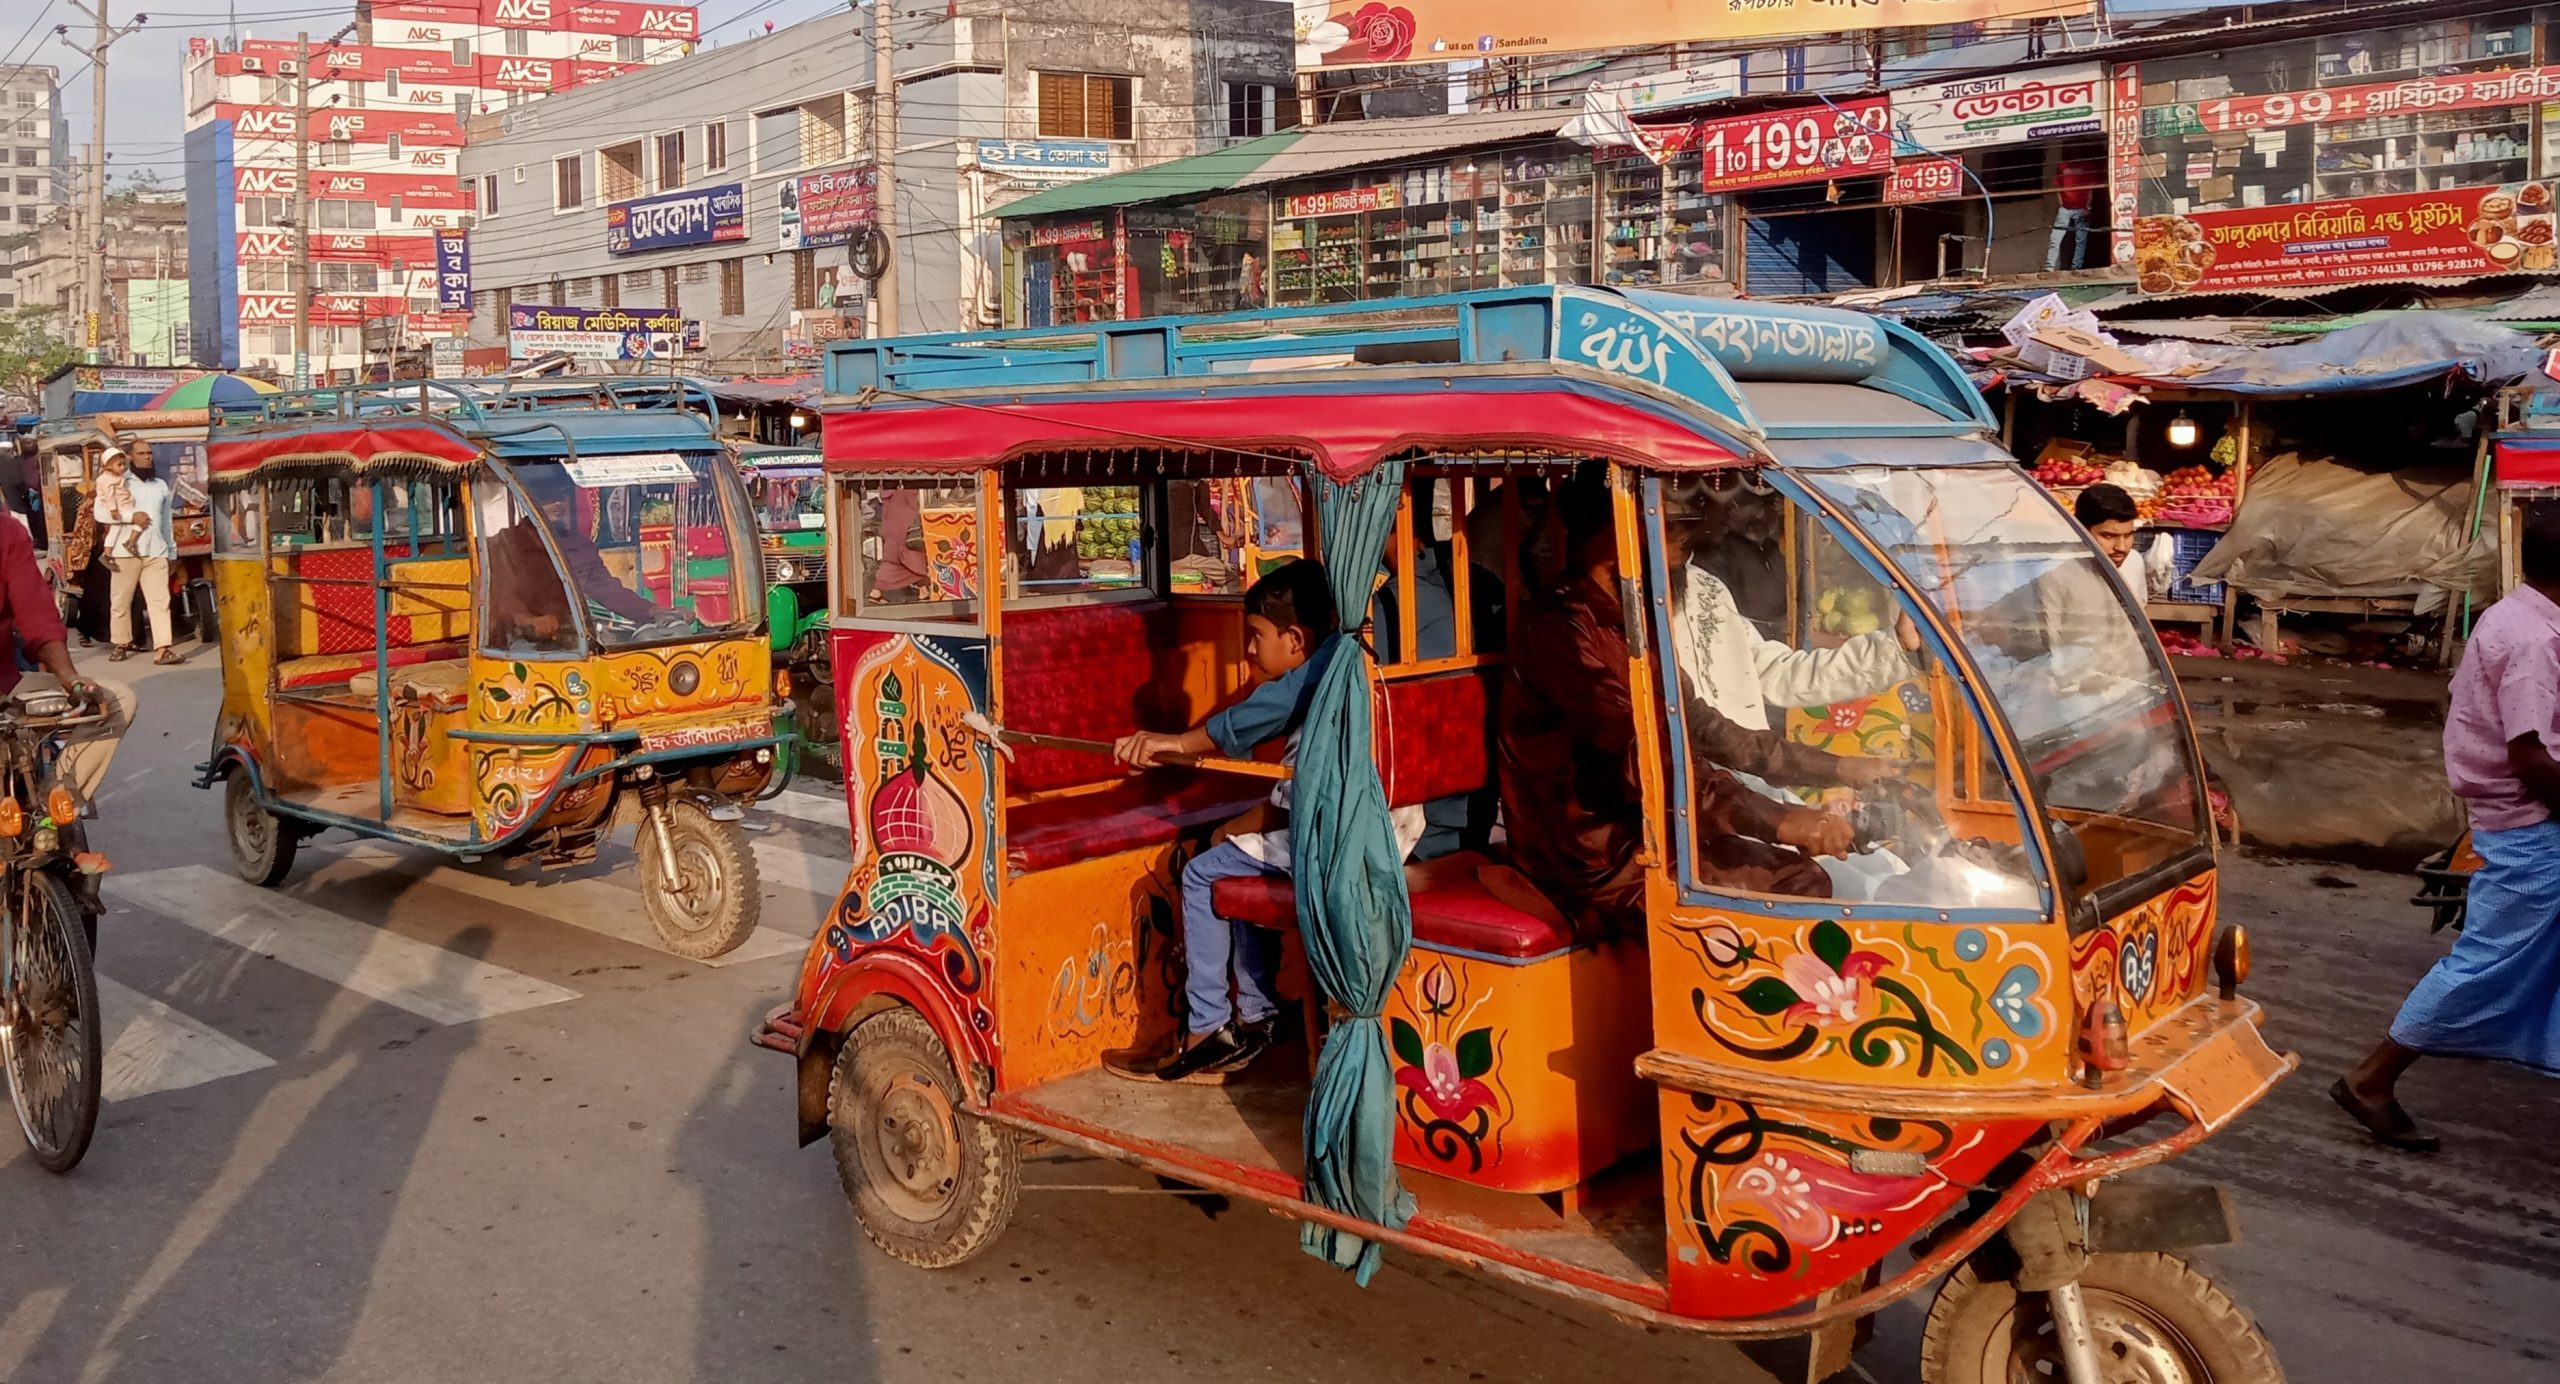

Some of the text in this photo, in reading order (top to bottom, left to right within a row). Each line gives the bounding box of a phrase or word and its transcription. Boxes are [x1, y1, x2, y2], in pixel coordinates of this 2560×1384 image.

[496, 0, 551, 20] AKS
[640, 10, 693, 32] AKS
[407, 27, 441, 41] AKS
[1496, 37, 1548, 49] /Sandalina
[580, 39, 612, 52] AKS
[326, 52, 362, 67] AKS
[497, 60, 552, 81] AKS
[1941, 77, 2007, 100] মাজেদা
[2119, 65, 2137, 97] 1
[409, 90, 443, 103] AKS
[1953, 81, 2096, 120] ডেন্টাল
[2118, 98, 2138, 112] to
[2206, 102, 2233, 130] 1
[2234, 111, 2259, 127] to
[2263, 91, 2331, 126] 99
[236, 110, 297, 133] AKS
[329, 115, 365, 131] AKS
[2116, 116, 2138, 146] 99
[980, 143, 1108, 164] ছবি তোলা হয়
[1706, 131, 1724, 177] 1
[1727, 147, 1747, 172] to
[1744, 118, 1820, 172] 199
[412, 152, 446, 165] AKS
[238, 169, 297, 192] AKS
[329, 177, 365, 191] AKS
[808, 175, 835, 194] ছবি
[1900, 176, 1913, 188] to
[1913, 166, 1953, 189] 199
[1292, 198, 1300, 215] 1
[1307, 195, 1327, 215] 99
[413, 215, 446, 228] AKS
[631, 196, 708, 240] অবকাশ
[2208, 221, 2291, 249] তালুকদার
[2294, 207, 2365, 240] বিরিয়ানি
[2370, 211, 2403, 231] এন্ড
[332, 236, 365, 248] AKS
[1046, 228, 1059, 243] 99
[2412, 258, 2486, 272] 01796-928176
[240, 298, 296, 318] AKS
[332, 298, 366, 311] AKS
[536, 311, 581, 330] রিয়াজ
[583, 313, 640, 332] মেডিসিন
[812, 319, 837, 337] ছবি
[870, 896, 951, 940] ADIBA
